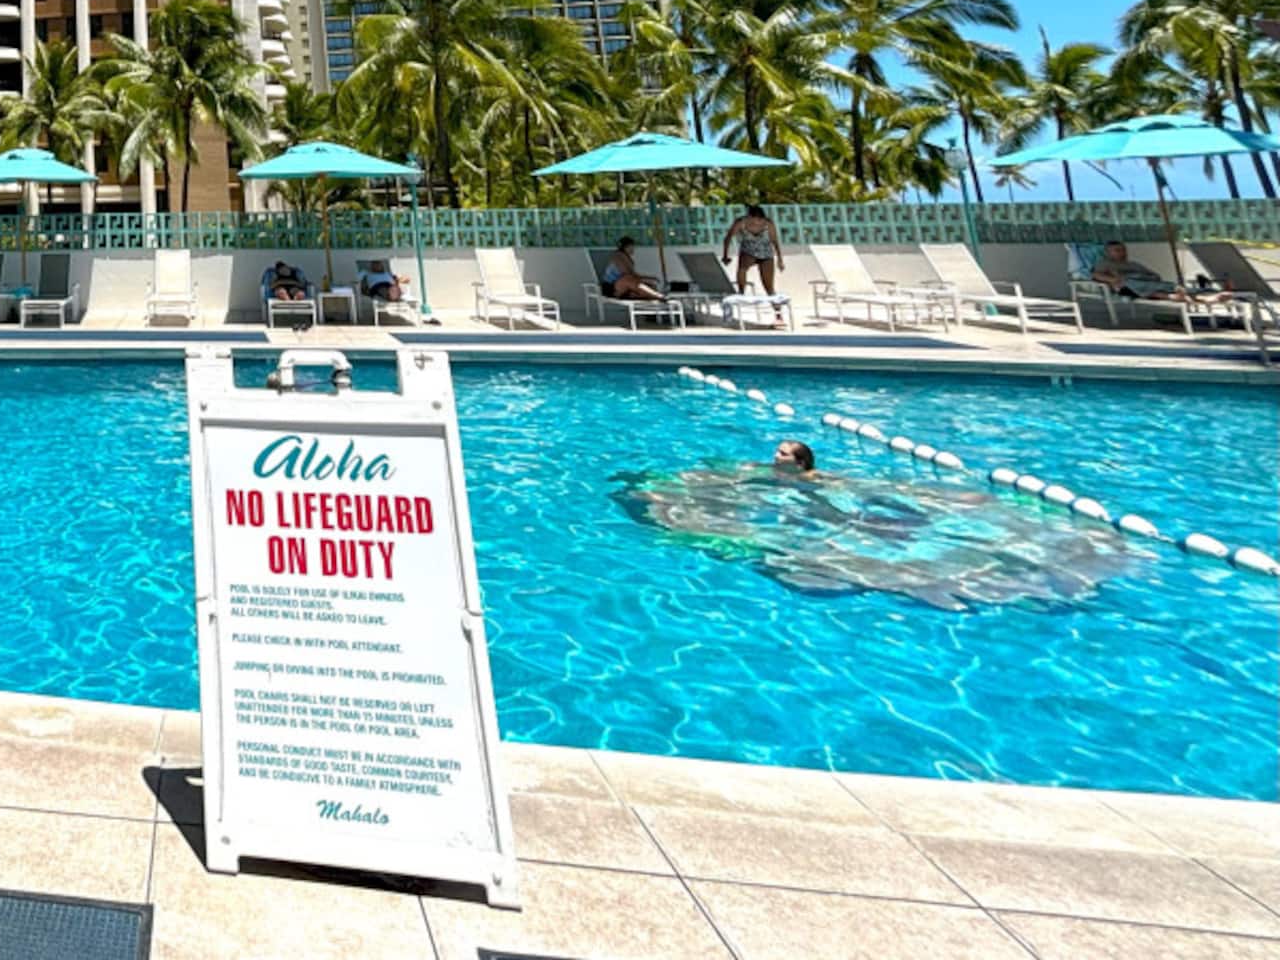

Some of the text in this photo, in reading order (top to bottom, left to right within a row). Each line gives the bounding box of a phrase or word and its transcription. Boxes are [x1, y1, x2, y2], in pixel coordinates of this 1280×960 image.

[252, 435, 396, 481] Aloha
[226, 489, 434, 534] NO LIFEGUARD
[268, 536, 394, 579] ON DUTY
[230, 584, 250, 594] POOL
[252, 585, 260, 594] IS
[294, 587, 310, 596] FOR
[312, 588, 327, 597] USE
[330, 589, 339, 598] OF
[369, 592, 405, 602] OWNERS
[230, 596, 247, 604] AND
[249, 596, 298, 608] REGISTERED
[231, 608, 245, 617] ALL
[248, 608, 279, 619] OTHERS
[282, 610, 300, 620] WILL
[303, 612, 313, 621] BE
[316, 612, 343, 623] ASKED
[345, 614, 356, 624] TO
[232, 633, 261, 644] PLEASE
[264, 635, 290, 645] CHECK
[294, 638, 302, 646] IN
[304, 638, 326, 647] WITH
[328, 639, 349, 650] POOL
[234, 660, 270, 672] JUMPING
[273, 663, 284, 672] OR
[286, 664, 314, 675] DIVING
[317, 667, 336, 677] INTO
[338, 668, 353, 679] THE
[356, 669, 378, 681] POOL
[381, 672, 389, 681] IS
[234, 688, 436, 713] POOL CHAIRS SHALL NOT BE RESERVED OR LEFT
[234, 701, 288, 714] UNATTENDED
[291, 706, 307, 715] FOR
[310, 707, 334, 718] MORE
[338, 709, 360, 720] THAN
[418, 717, 454, 728] UNLESS
[236, 713, 251, 723] THE
[254, 715, 287, 726] PERSON
[290, 719, 297, 728] IS
[300, 719, 309, 728] IN
[311, 719, 327, 730] THE
[330, 721, 351, 732] POOL
[354, 723, 366, 733] OR
[368, 724, 391, 736] POOL
[237, 740, 461, 771] PERSONAL CONDUCT MUST BE IN ACCORDANCE WITH
[238, 753, 288, 768] STANDARDS
[290, 759, 301, 768] OF
[304, 759, 328, 770] GOOD
[361, 765, 402, 777] COMMON
[238, 767, 256, 777] AND
[259, 768, 270, 779] BE
[272, 769, 321, 784] CONDUCIVE
[323, 774, 335, 785] TO
[345, 776, 376, 790] FAMILY
[316, 800, 389, 825] Mahalo
